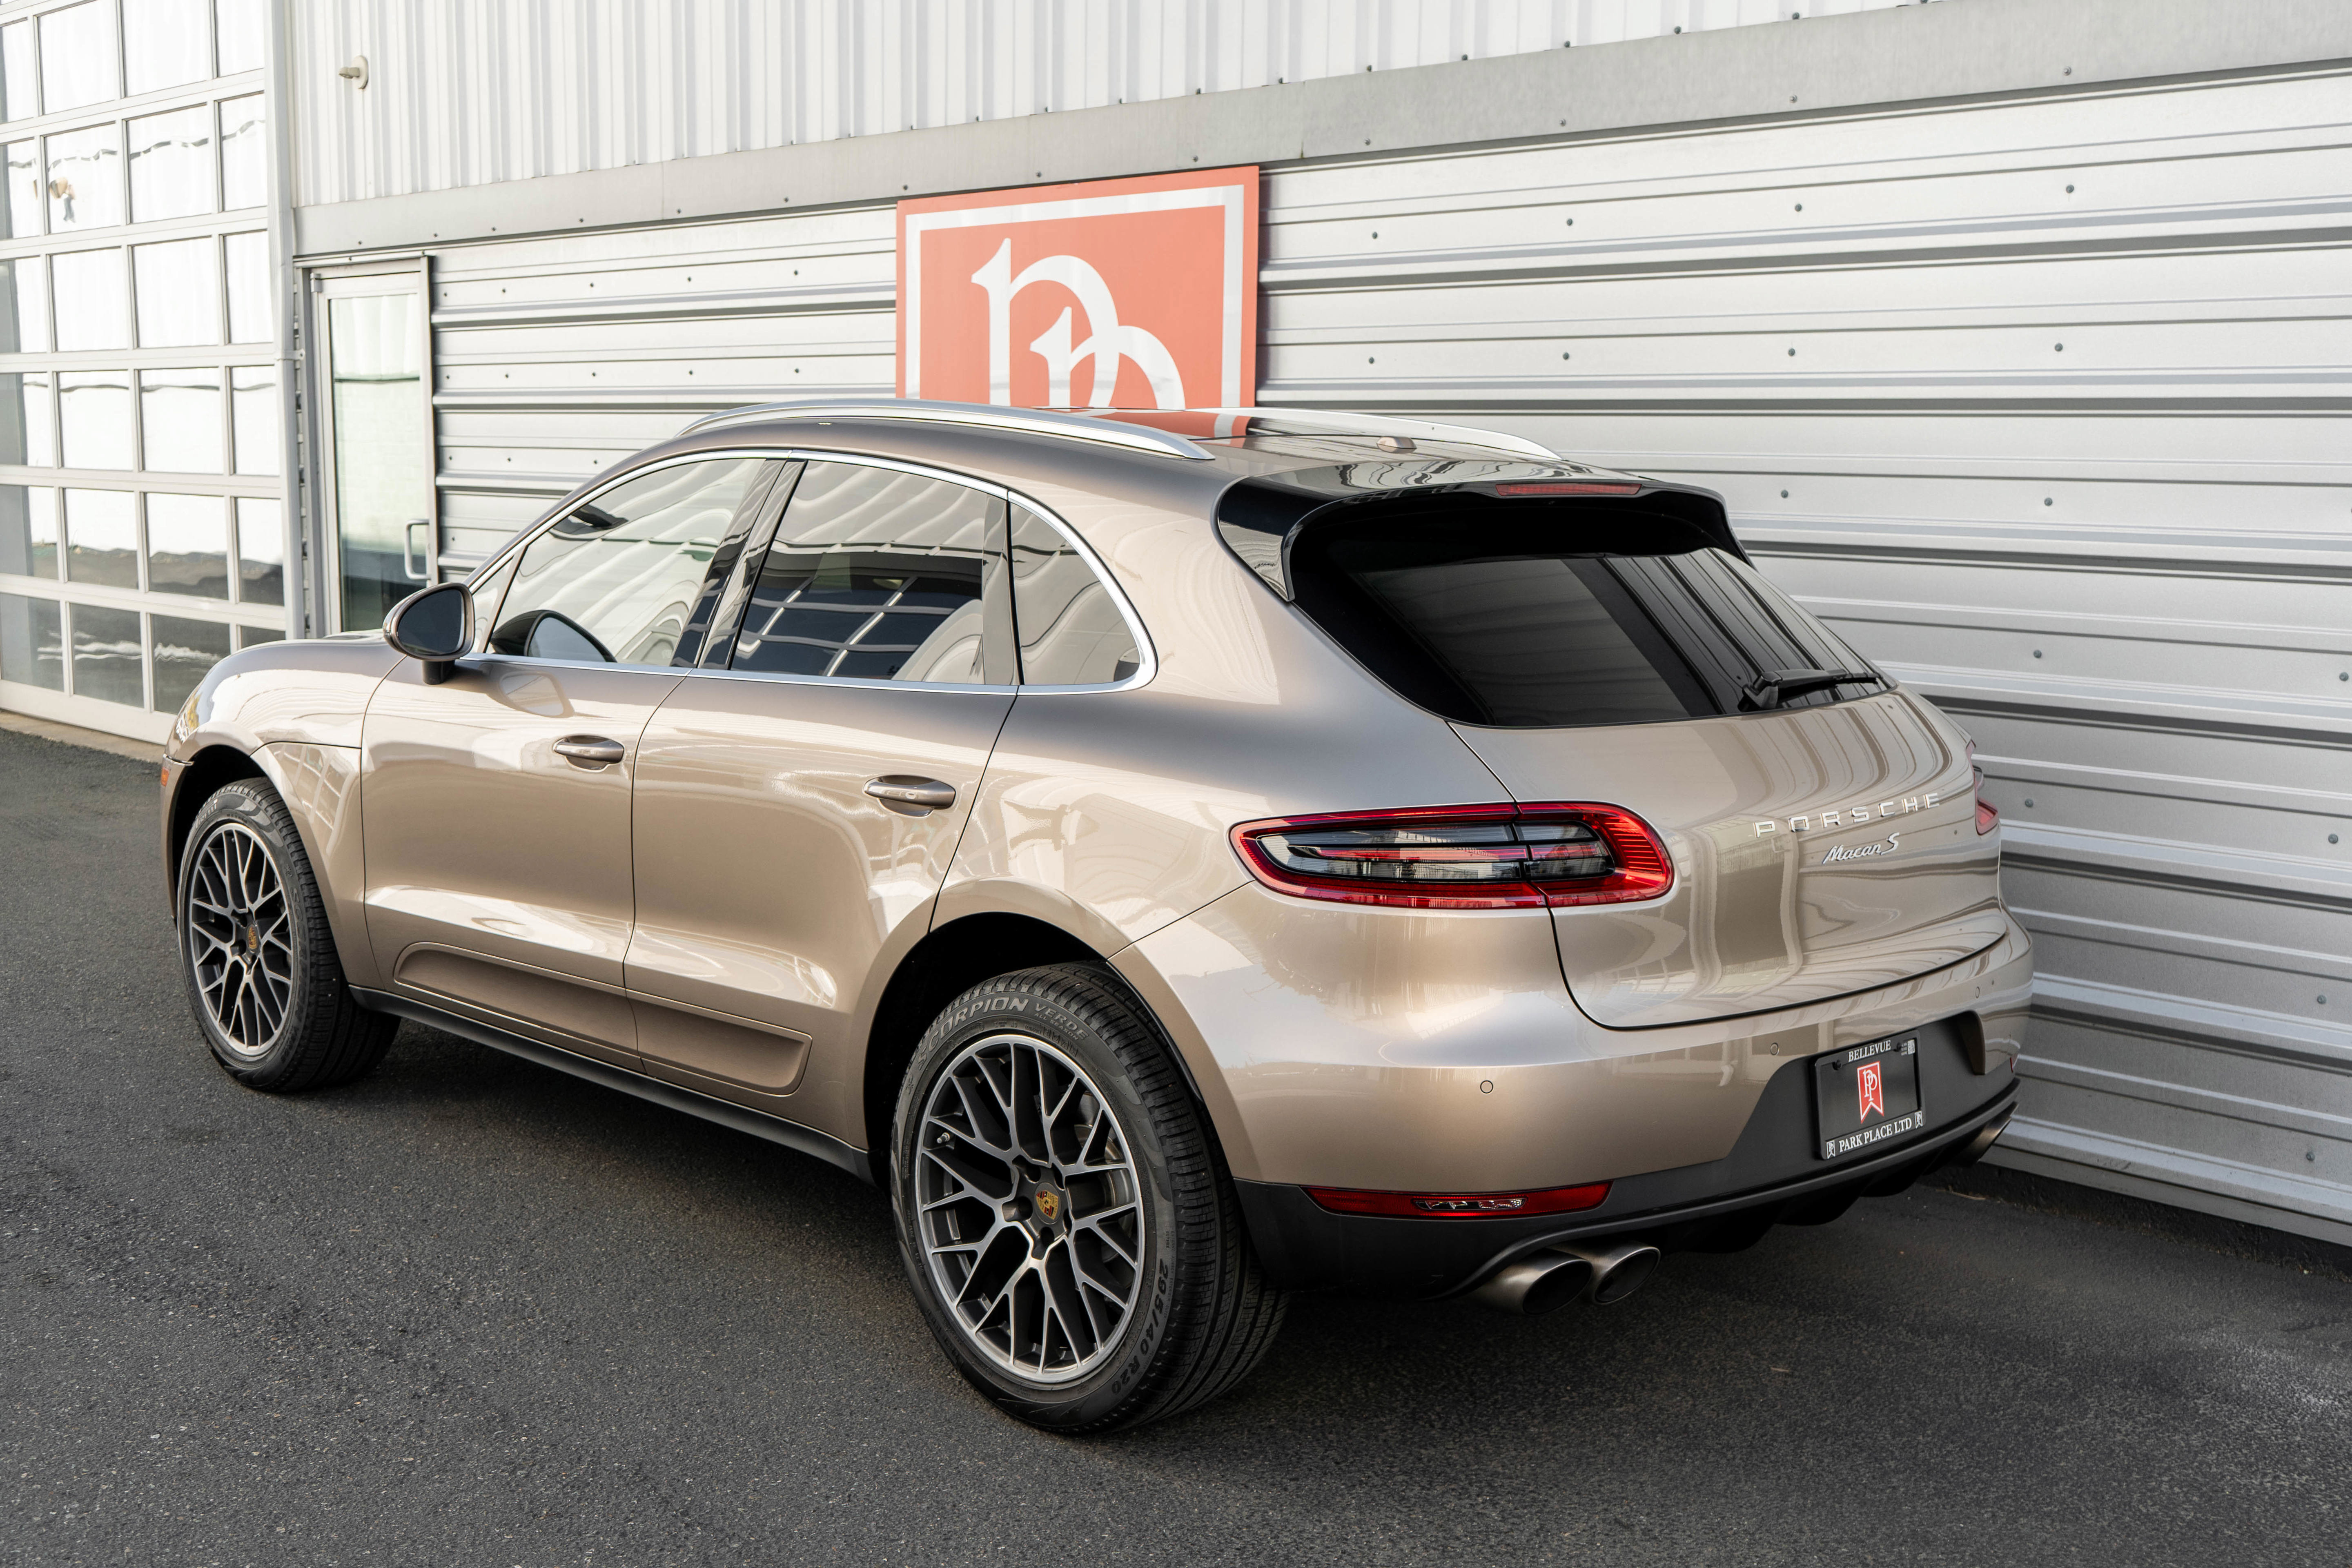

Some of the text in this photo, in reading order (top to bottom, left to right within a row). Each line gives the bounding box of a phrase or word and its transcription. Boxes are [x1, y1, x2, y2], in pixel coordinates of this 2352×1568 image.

[1753, 793, 1940, 838] PORSCHE
[1822, 832, 1900, 865] Macan S
[918, 996, 1029, 1071] SCORPION
[1035, 1003, 1089, 1040] VERDE
[1050, 1020, 1078, 1040] SEASON
[1848, 1040, 1891, 1062] BELLEVUE
[1839, 1118, 1912, 1152] PARK PLACE LTD
[1140, 1258, 1169, 1356] 295/40
[1111, 1355, 1140, 1396] R20
